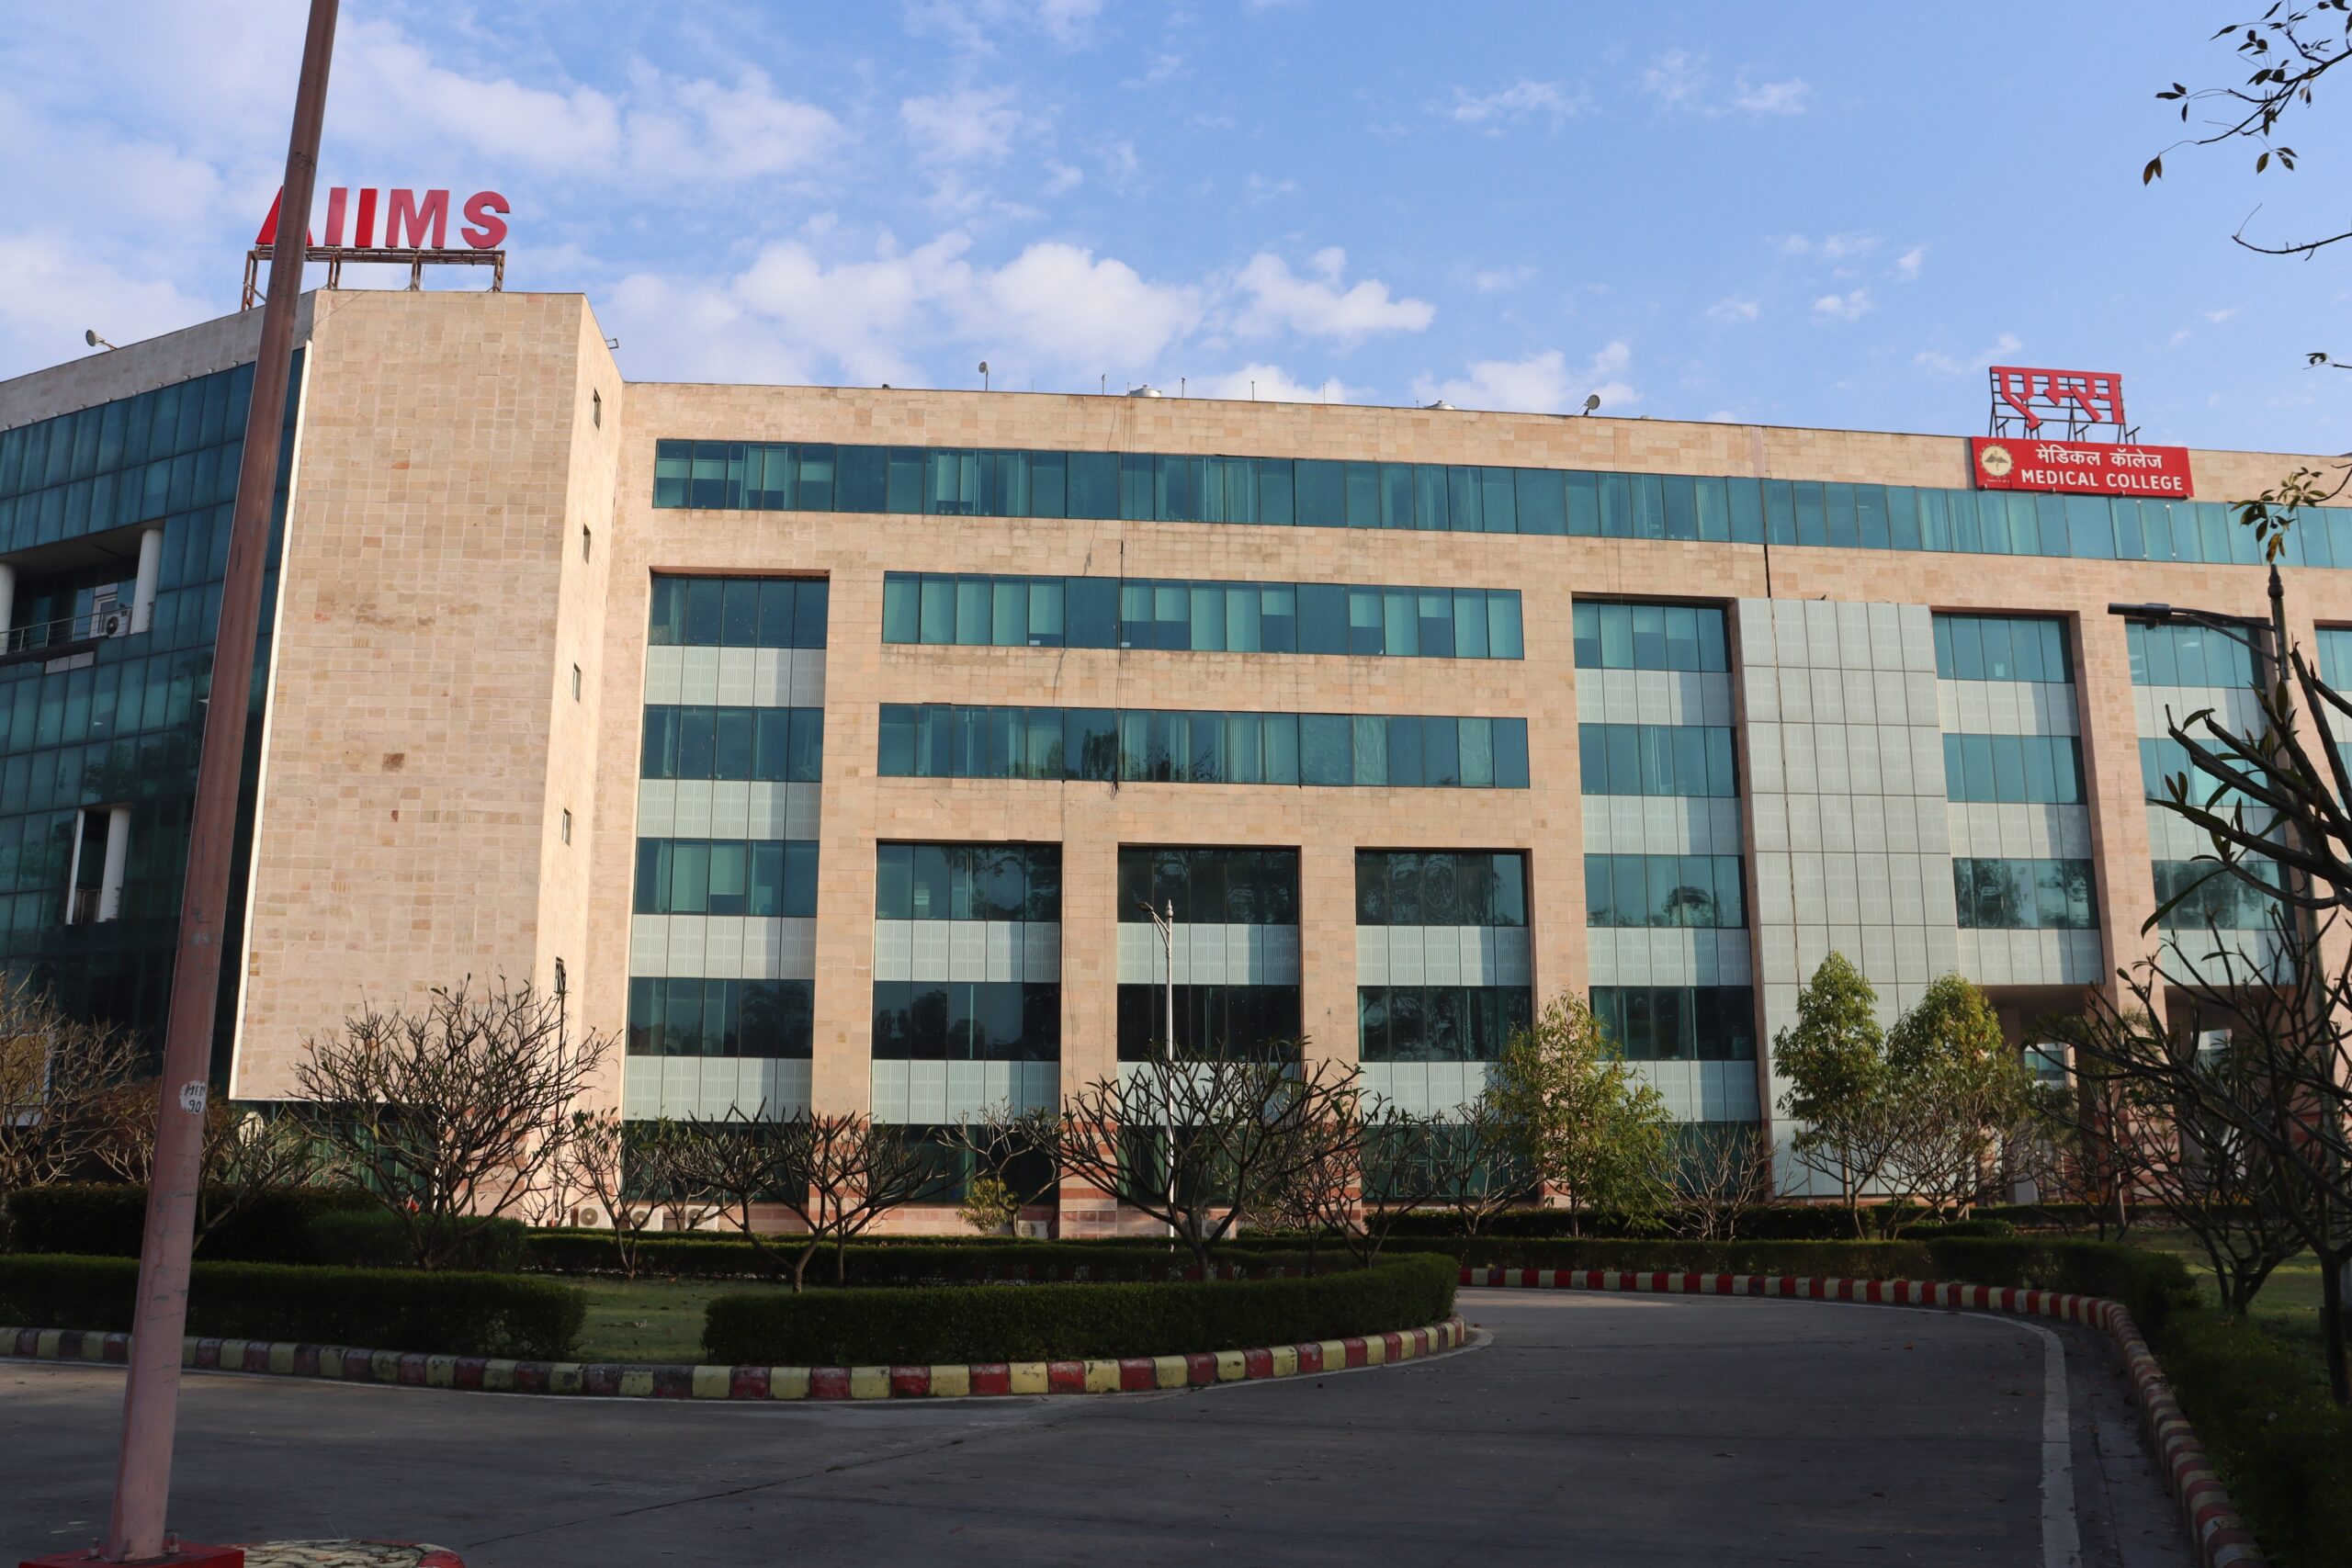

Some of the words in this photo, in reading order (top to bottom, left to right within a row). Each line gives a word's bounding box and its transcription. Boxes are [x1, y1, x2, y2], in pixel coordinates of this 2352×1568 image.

[1990, 366, 2124, 429] एम्स
[2035, 443, 2101, 467] मेडिकल
[2109, 447, 2163, 469] कॉलेज
[2020, 468, 2099, 487] MEDICAL
[2106, 473, 2184, 491] COLLEGE
[188, 1100, 201, 1112] 90
